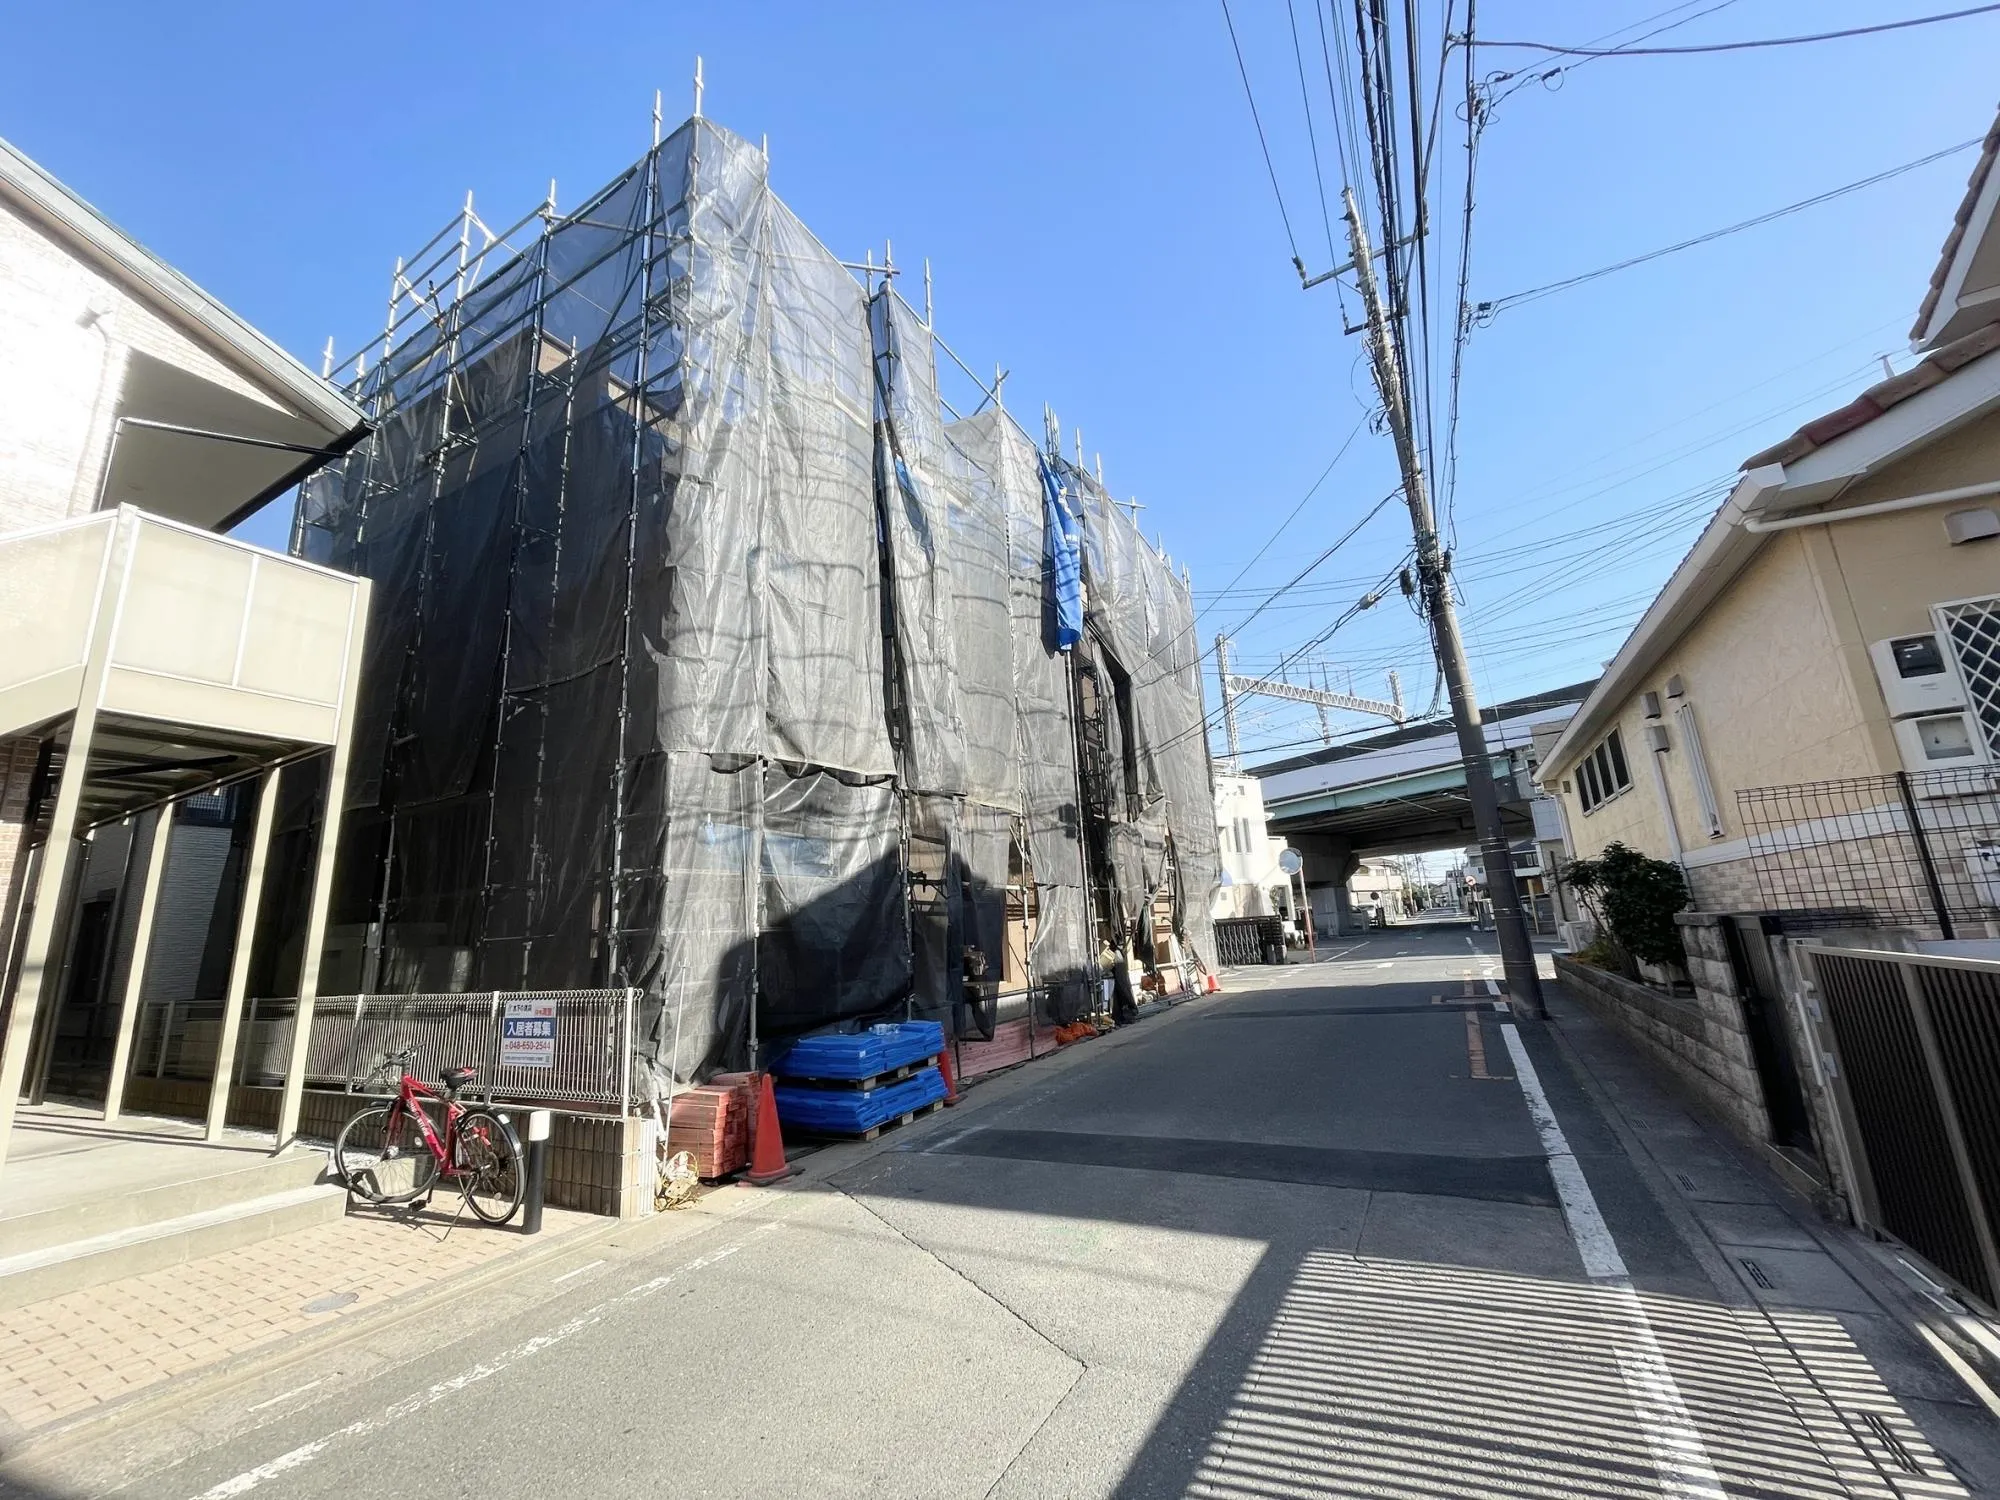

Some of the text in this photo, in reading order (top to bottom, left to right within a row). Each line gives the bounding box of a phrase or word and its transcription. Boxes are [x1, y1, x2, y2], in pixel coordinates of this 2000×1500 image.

[507, 1022, 551, 1036] 入居者募集
